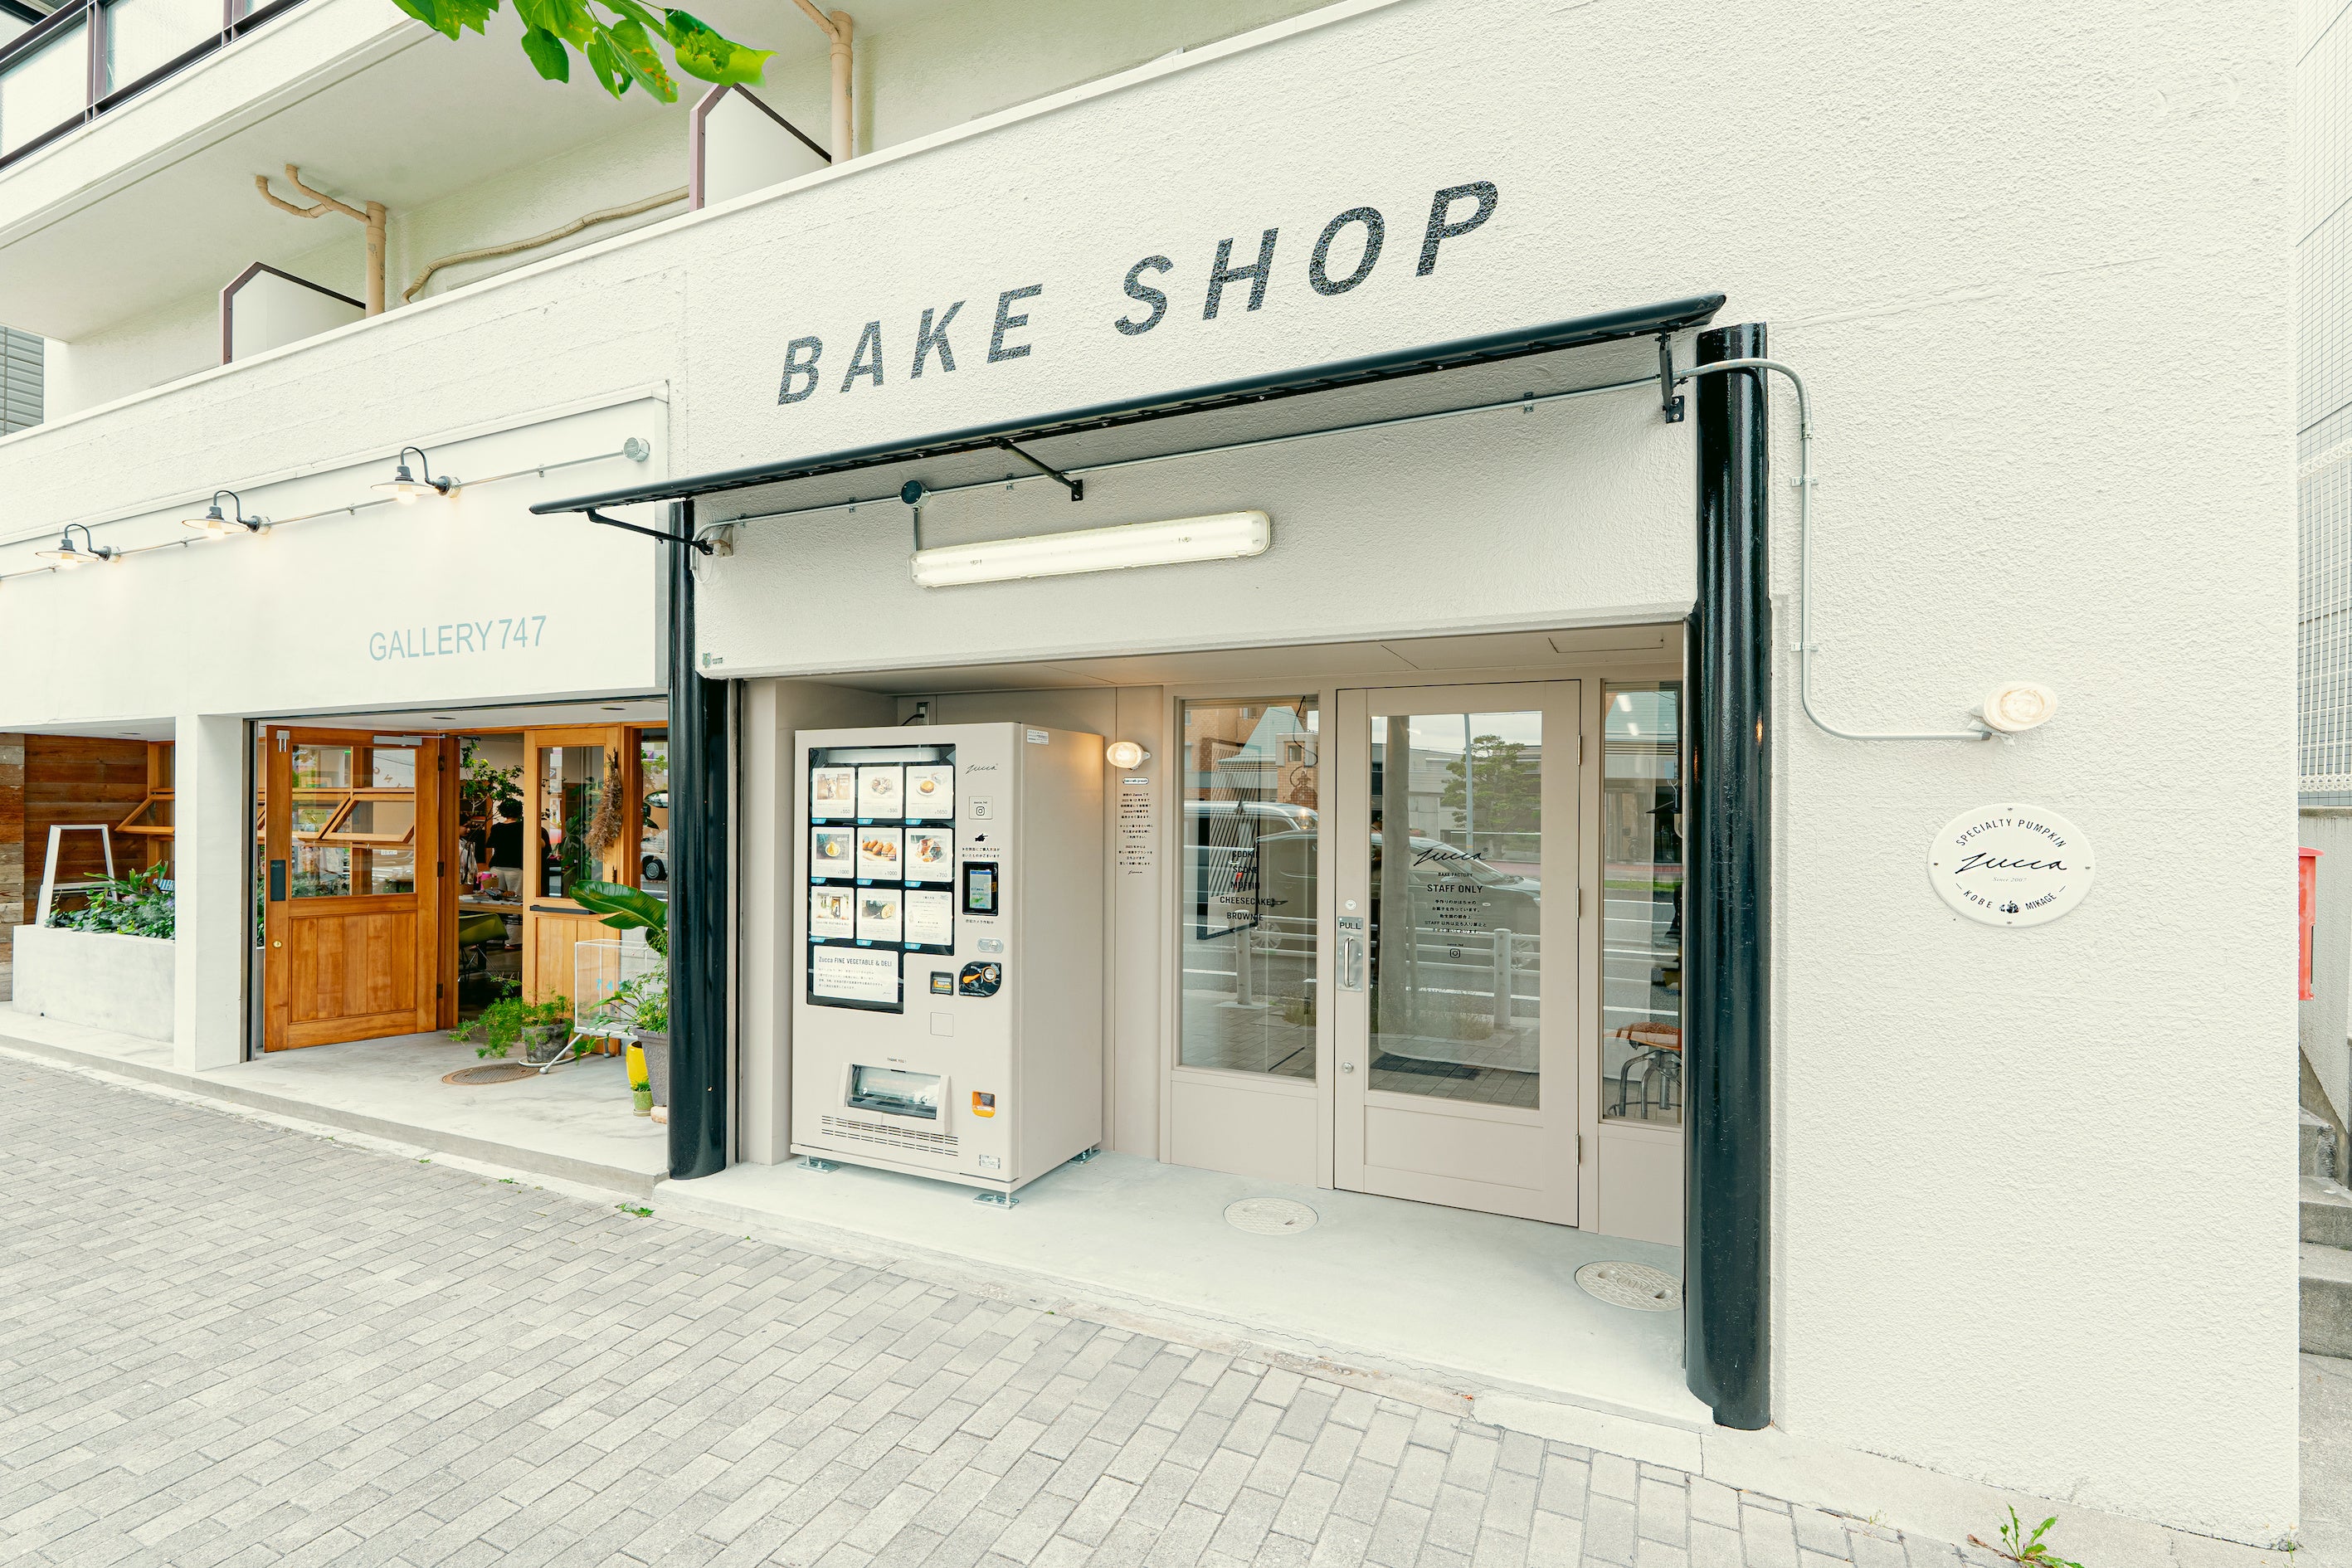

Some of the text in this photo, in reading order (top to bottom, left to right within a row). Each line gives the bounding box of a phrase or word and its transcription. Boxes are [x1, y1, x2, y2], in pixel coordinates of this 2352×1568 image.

[778, 180, 1498, 406] BAKE SHOP
[1955, 819, 2067, 848] SPECIALTY PUMPKIN
[1232, 850, 1259, 859] COOKI
[1233, 865, 1258, 874] SCONE
[1230, 881, 1260, 890] MUFFIN
[1427, 884, 1483, 894] STAFF ONLY
[1220, 896, 1270, 906] CHEESECAKE
[1963, 889, 2057, 911] KOBE MIKAGE
[1226, 912, 1263, 921] BROWNIE
[1339, 922, 1361, 930] PULL
